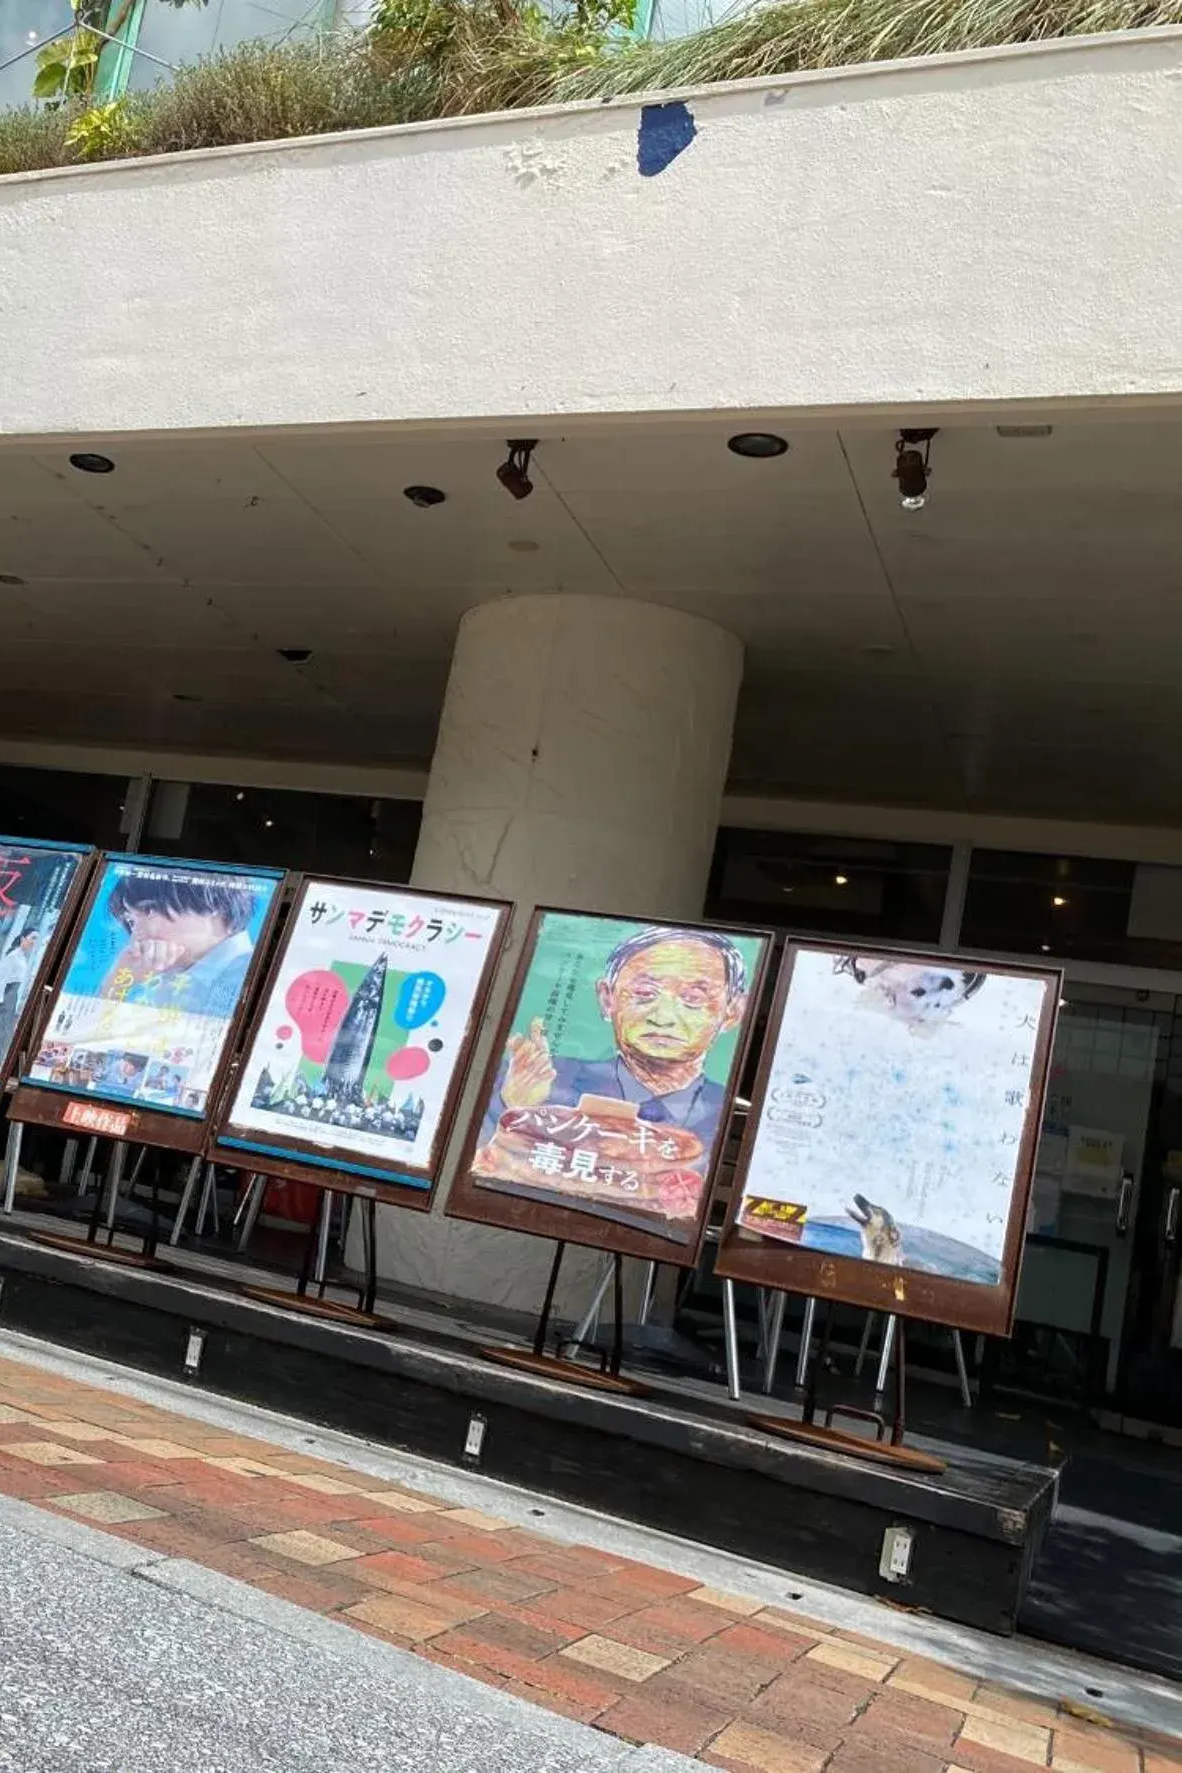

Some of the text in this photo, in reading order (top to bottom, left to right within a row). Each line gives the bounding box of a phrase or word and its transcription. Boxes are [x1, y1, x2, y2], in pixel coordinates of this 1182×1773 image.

[309, 900, 483, 944] サンマデモクラシー
[506, 1108, 679, 1160] パンケーキを
[986, 1014, 1037, 1225] 犬は歌わない
[528, 1141, 640, 1191] 毒見する
